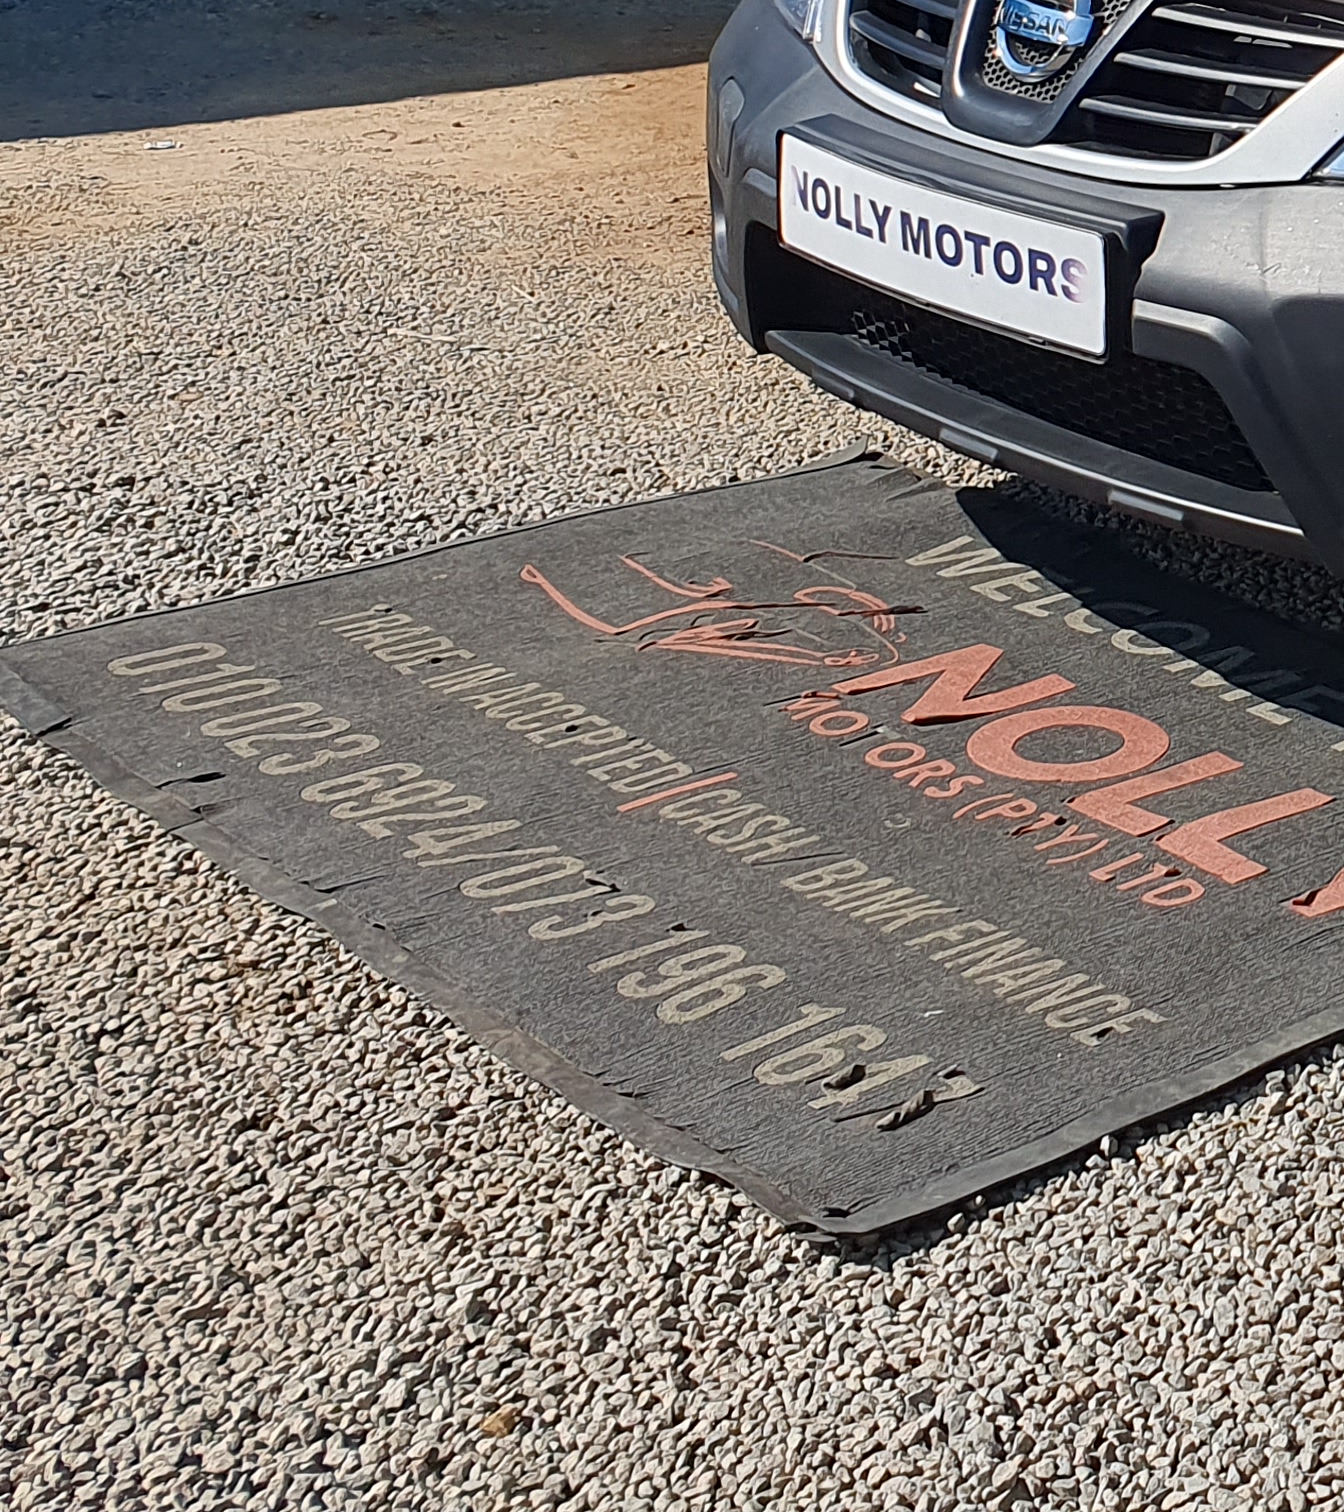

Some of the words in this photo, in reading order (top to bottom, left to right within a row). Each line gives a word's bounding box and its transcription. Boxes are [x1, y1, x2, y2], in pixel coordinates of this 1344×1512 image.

[791, 164, 893, 244] NOLLY
[900, 209, 1088, 304] MOTORS
[318, 603, 478, 675] TRADE
[420, 662, 518, 696] IN
[458, 682, 694, 794] ACCEPTED
[778, 690, 985, 799] MOTORS
[952, 792, 1109, 866] (PTY)
[1088, 852, 1206, 908] LTD
[106, 642, 284, 713] 010
[200, 701, 381, 776] 023
[586, 929, 788, 1025] 196
[904, 919, 1169, 1048] FINANCE
